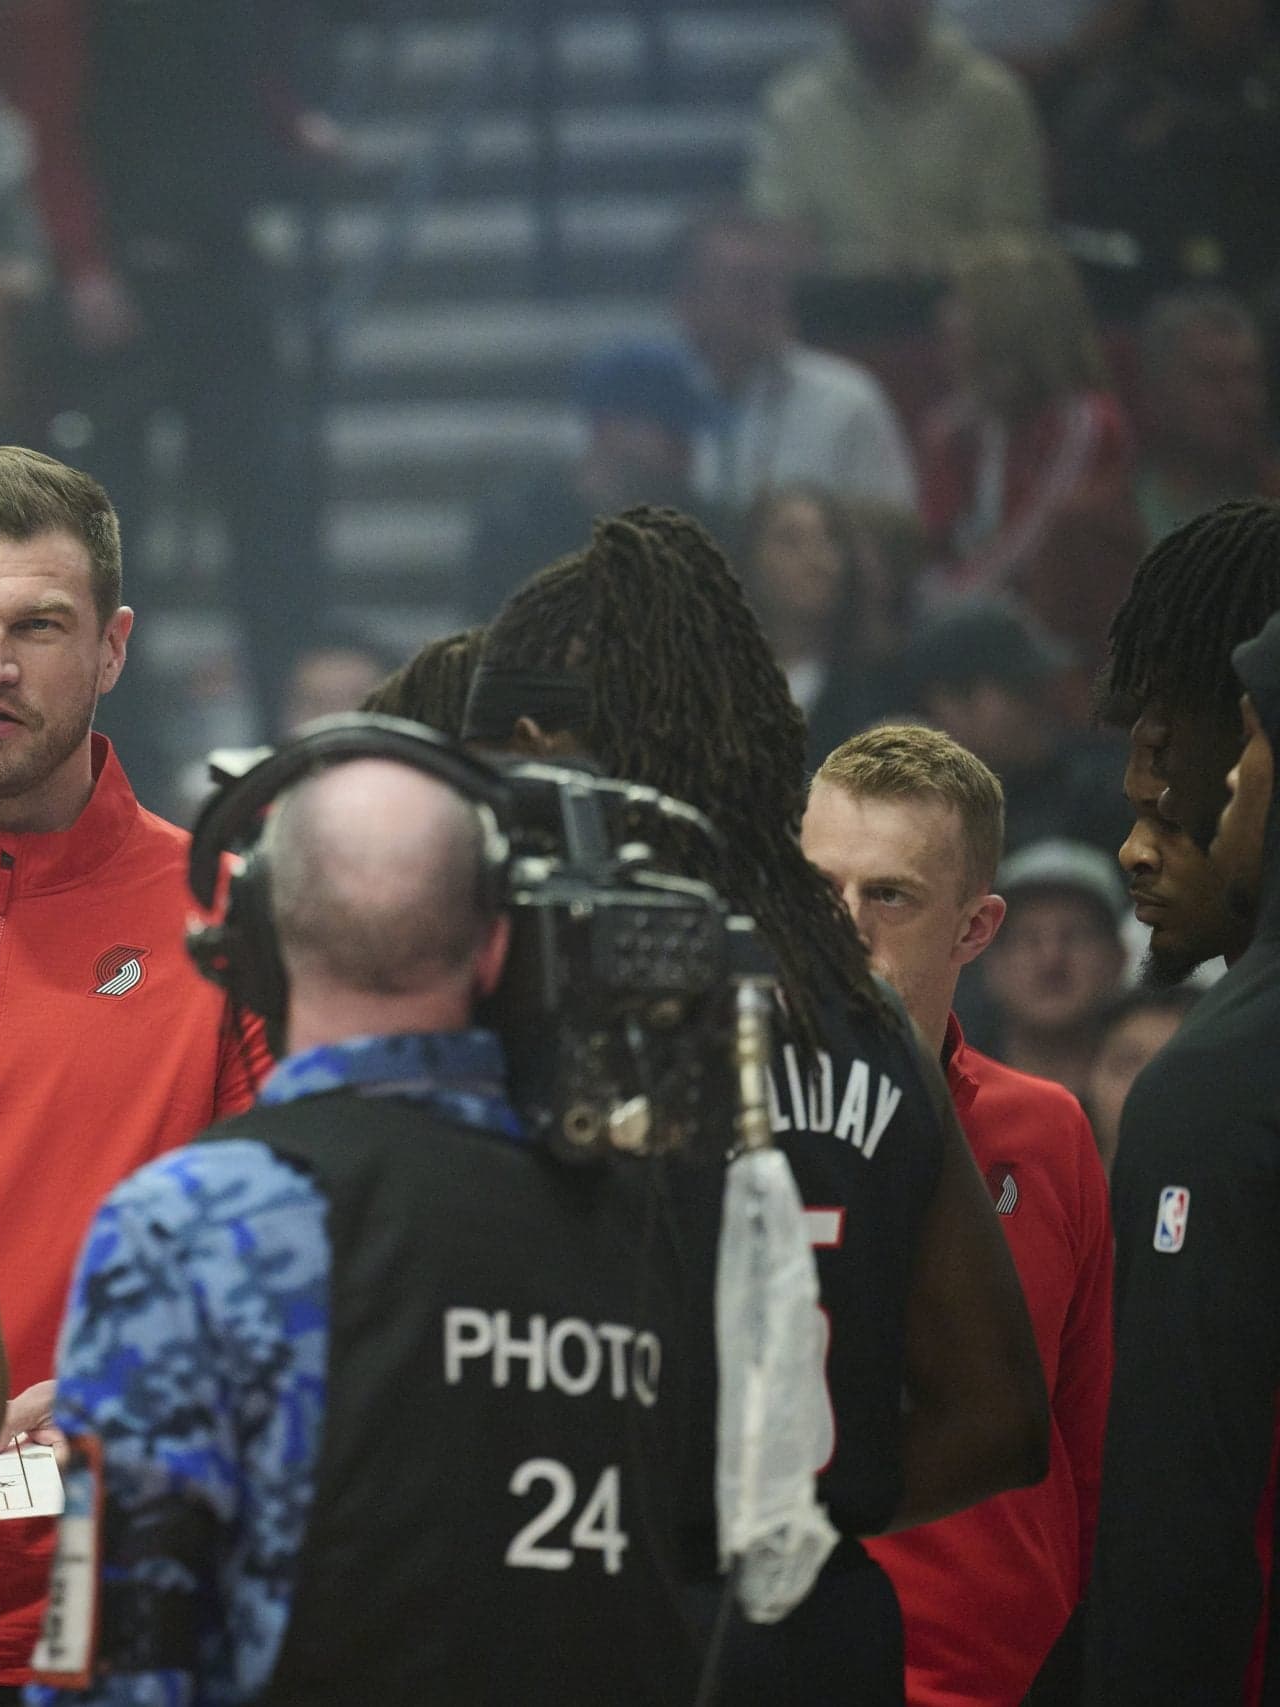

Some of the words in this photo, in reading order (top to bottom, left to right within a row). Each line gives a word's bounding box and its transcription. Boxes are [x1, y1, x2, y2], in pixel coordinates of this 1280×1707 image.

[765, 1042, 903, 1160] LIDAY
[443, 1306, 662, 1407] PHOTO
[504, 1457, 630, 1576] 24
